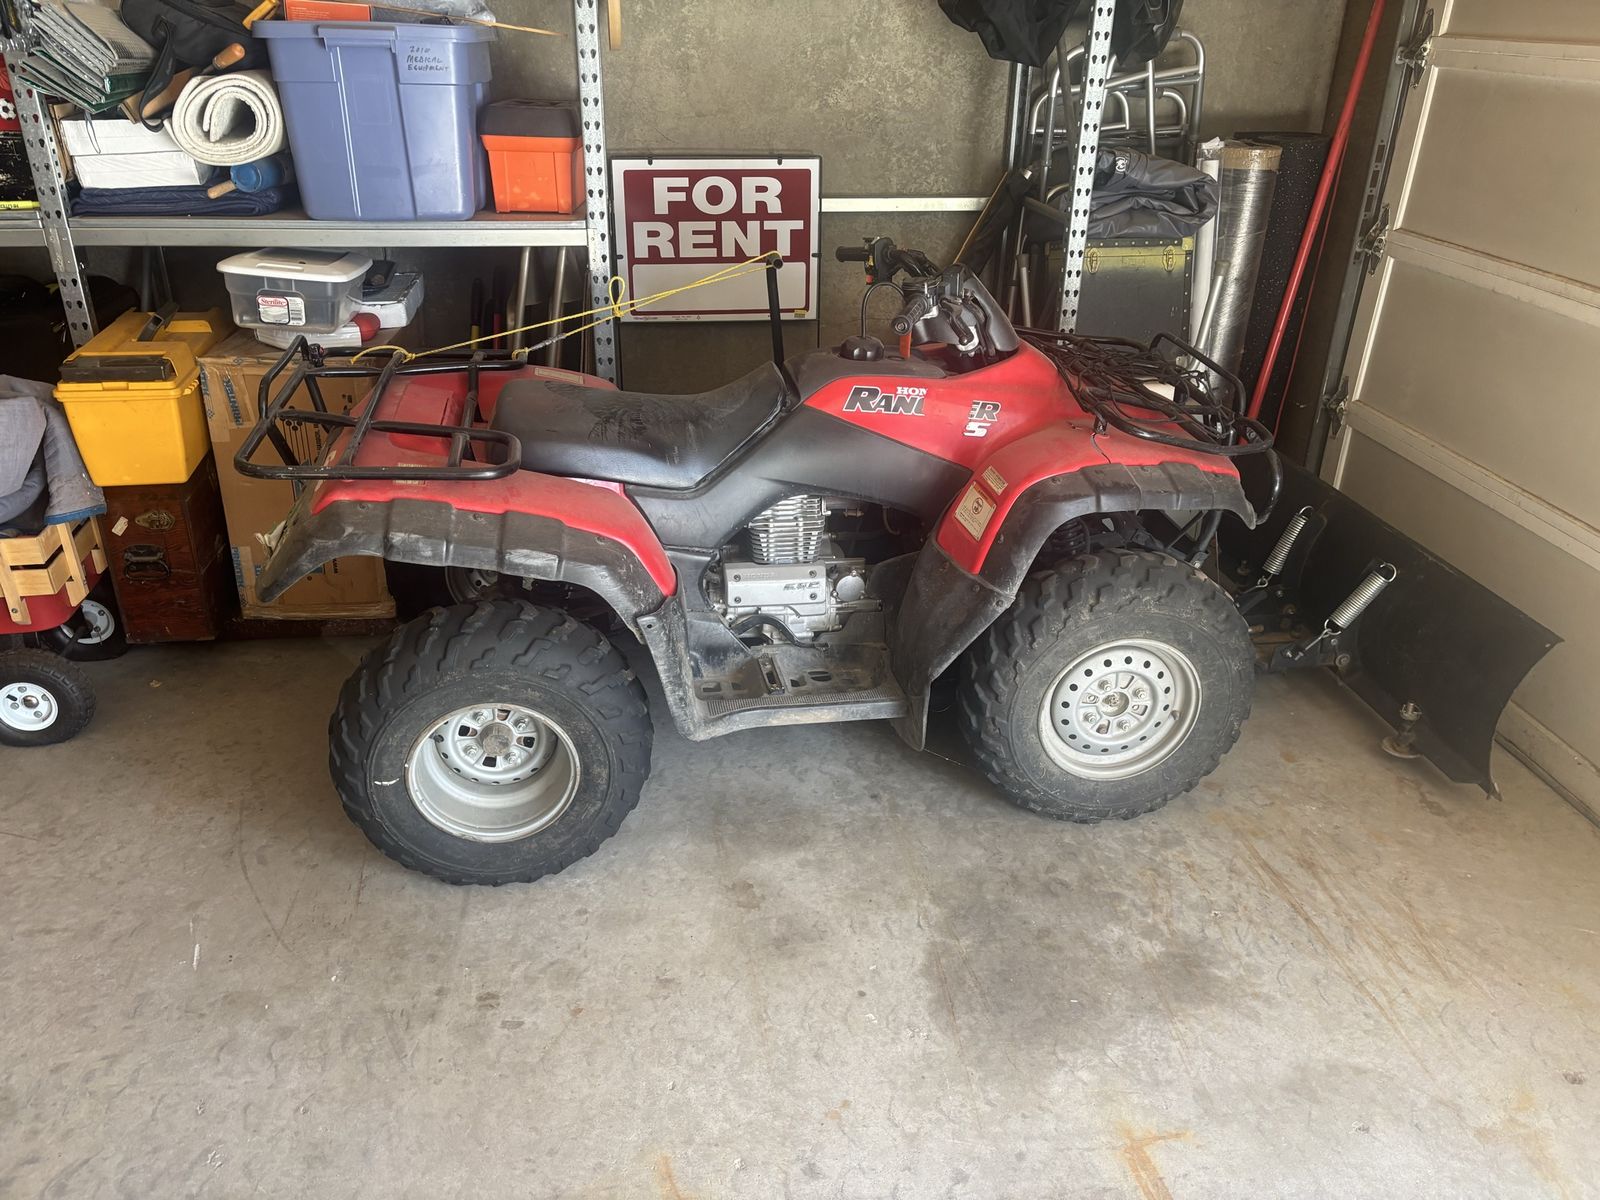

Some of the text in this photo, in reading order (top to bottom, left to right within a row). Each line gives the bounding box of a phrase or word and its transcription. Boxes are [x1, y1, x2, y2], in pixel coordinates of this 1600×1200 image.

[406, 54, 443, 63] MEDICAL
[653, 176, 782, 215] FOR
[633, 220, 804, 259] RENT
